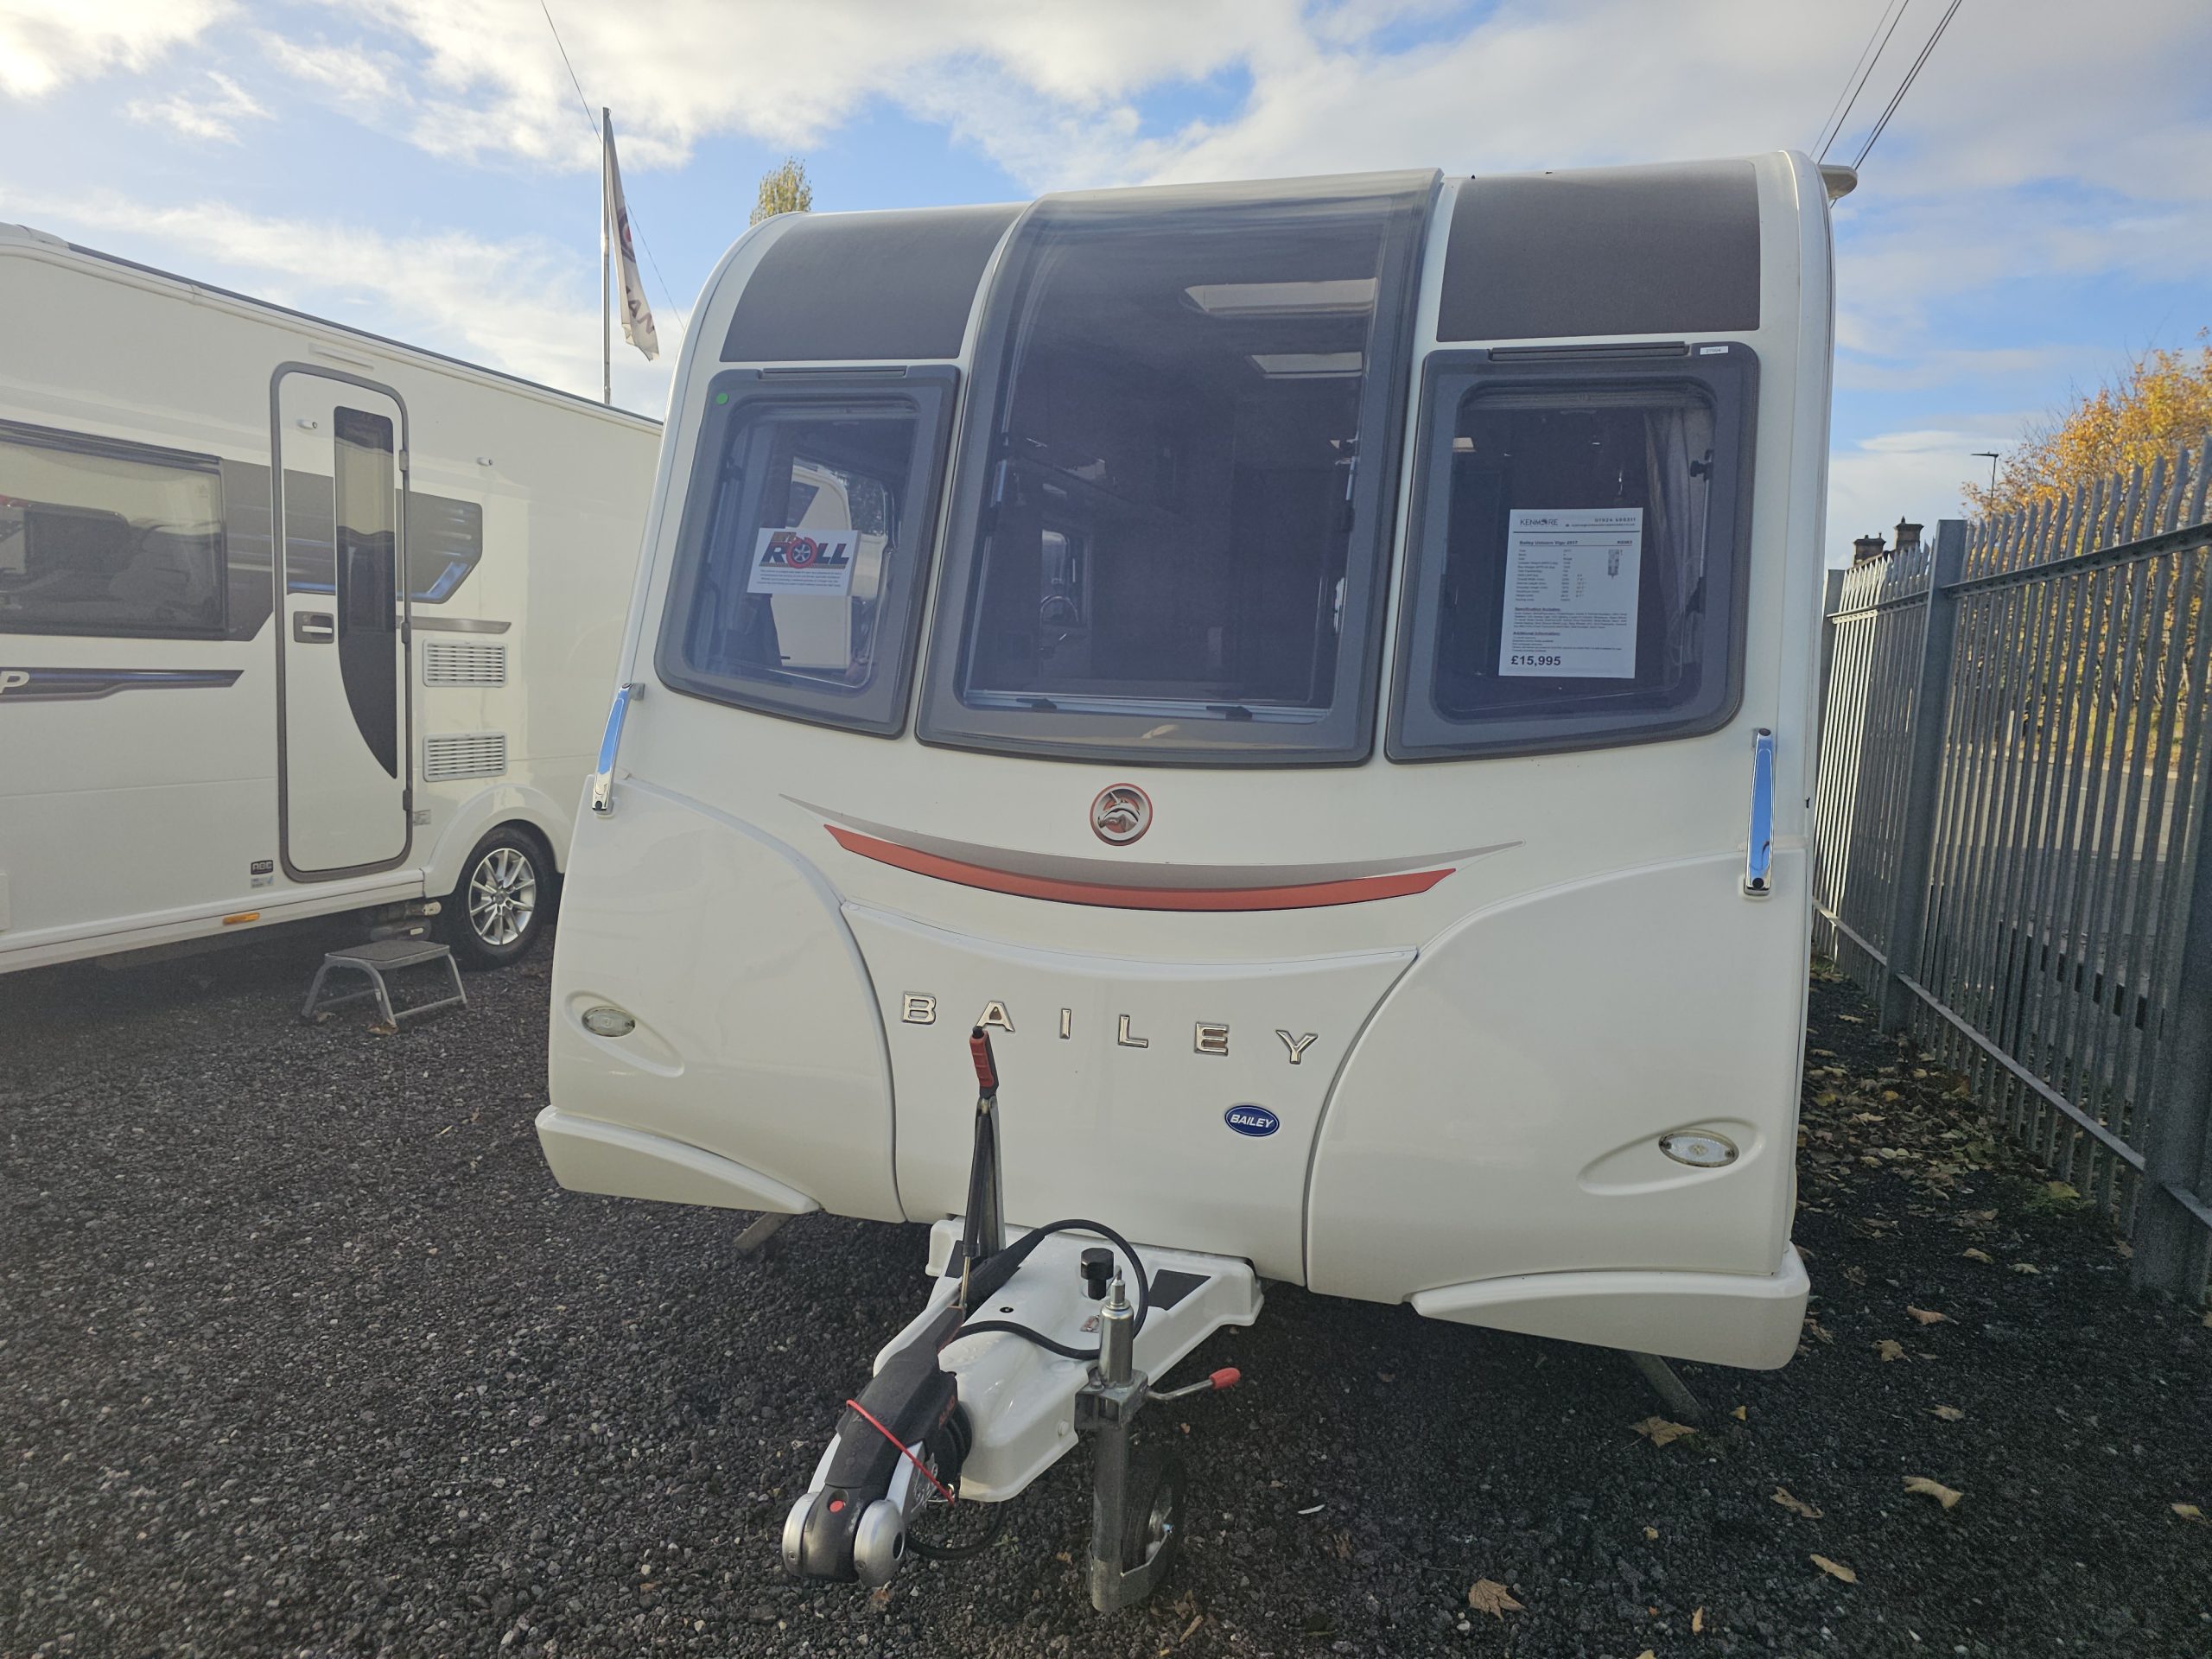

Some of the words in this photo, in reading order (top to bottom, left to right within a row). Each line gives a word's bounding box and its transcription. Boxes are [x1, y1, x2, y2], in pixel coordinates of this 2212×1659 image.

[1511, 656, 1561, 667] £15,995
[902, 992, 1319, 1065] BAILEY
[1230, 1114, 1274, 1128] BAILEY
